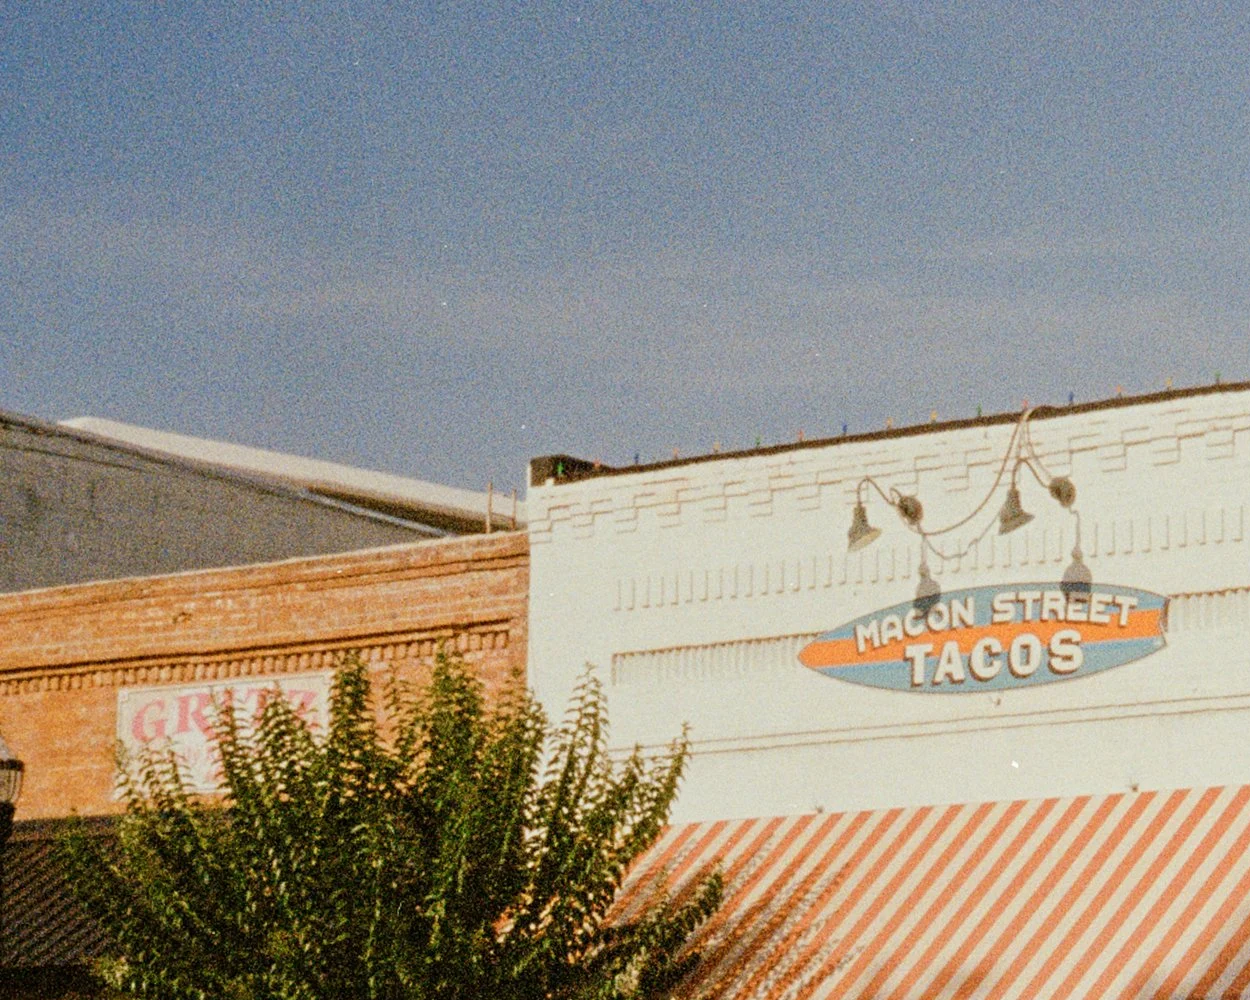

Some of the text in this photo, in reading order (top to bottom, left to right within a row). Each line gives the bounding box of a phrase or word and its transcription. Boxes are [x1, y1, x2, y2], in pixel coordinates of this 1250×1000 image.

[853, 590, 1138, 654] MACON STREET
[903, 629, 1084, 687] TACOS
